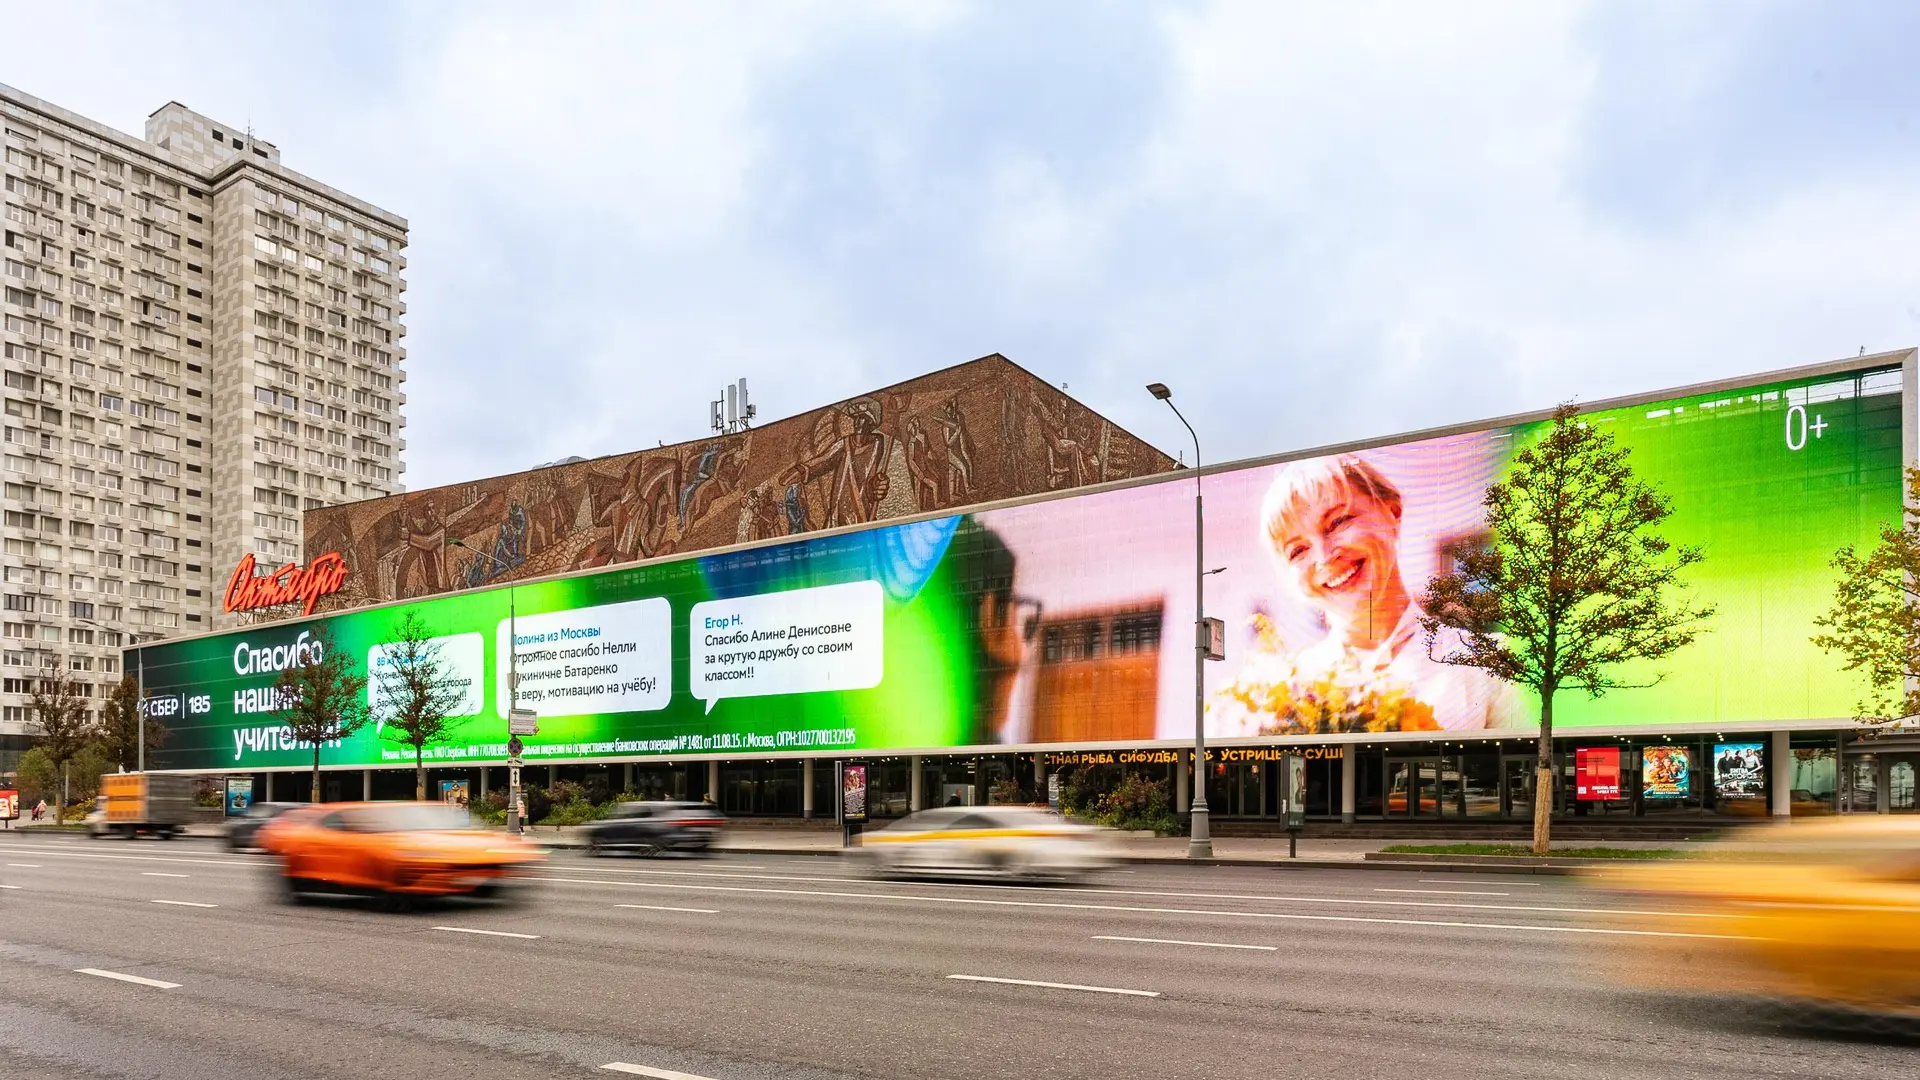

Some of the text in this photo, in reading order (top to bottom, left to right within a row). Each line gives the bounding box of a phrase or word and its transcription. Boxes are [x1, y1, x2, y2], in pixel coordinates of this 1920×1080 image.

[1785, 404, 1828, 451] 0+
[224, 552, 349, 616] Октябрь
[705, 614, 743, 629] Егор Н.
[547, 632, 559, 642] из
[560, 627, 601, 640] Москвы
[704, 622, 852, 646] Спасибо Алине Денисовне
[234, 630, 323, 675] Спасибо
[559, 643, 600, 659] спасибо
[602, 642, 637, 655] Нелли
[704, 642, 853, 665] за крутую дружбу со своим
[514, 664, 618, 686] укиничне Батаренко
[704, 666, 755, 681] классом!!
[521, 690, 546, 702] веру,
[547, 684, 605, 698] мотивацию
[606, 683, 619, 694] на
[621, 677, 656, 695] учёбу!
[150, 695, 211, 717] СБЕР 185
[704, 737, 712, 749] от
[1030, 755, 1079, 765] ЧСТНАЯ
[1081, 754, 1114, 764] РЫБА
[1119, 752, 1179, 763] СИФУДБА
